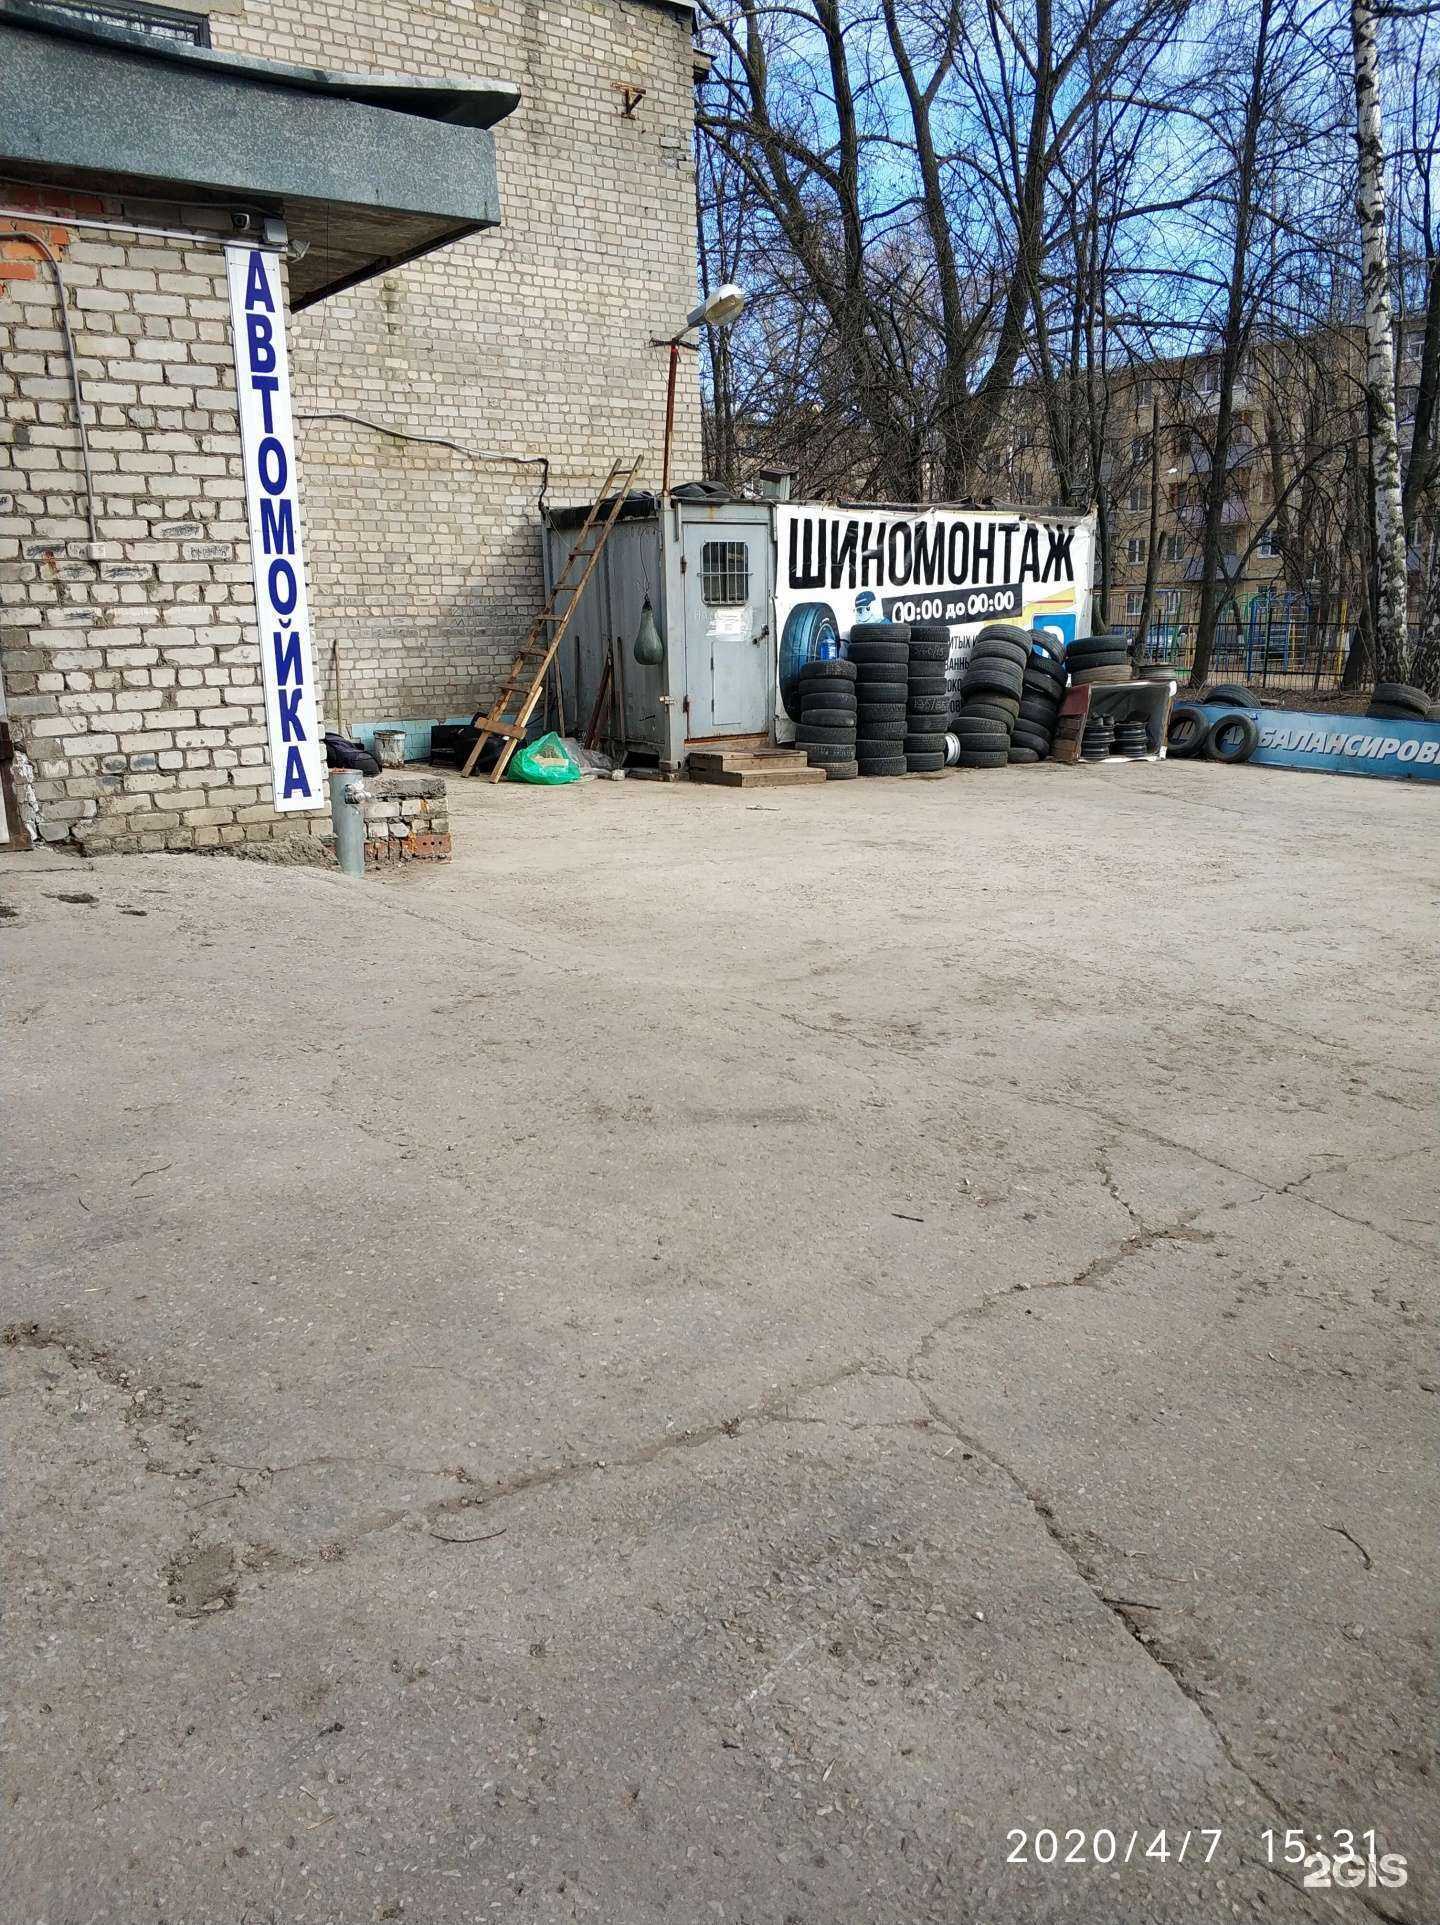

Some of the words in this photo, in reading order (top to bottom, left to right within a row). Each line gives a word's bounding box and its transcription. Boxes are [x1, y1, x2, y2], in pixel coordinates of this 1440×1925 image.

[245, 251, 310, 798] АВТОМОЙКА
[788, 517, 1075, 589] ШИНОМОНТАЖ
[892, 598, 943, 623] 00:00
[945, 602, 966, 620] до
[967, 590, 1015, 616] 00:00
